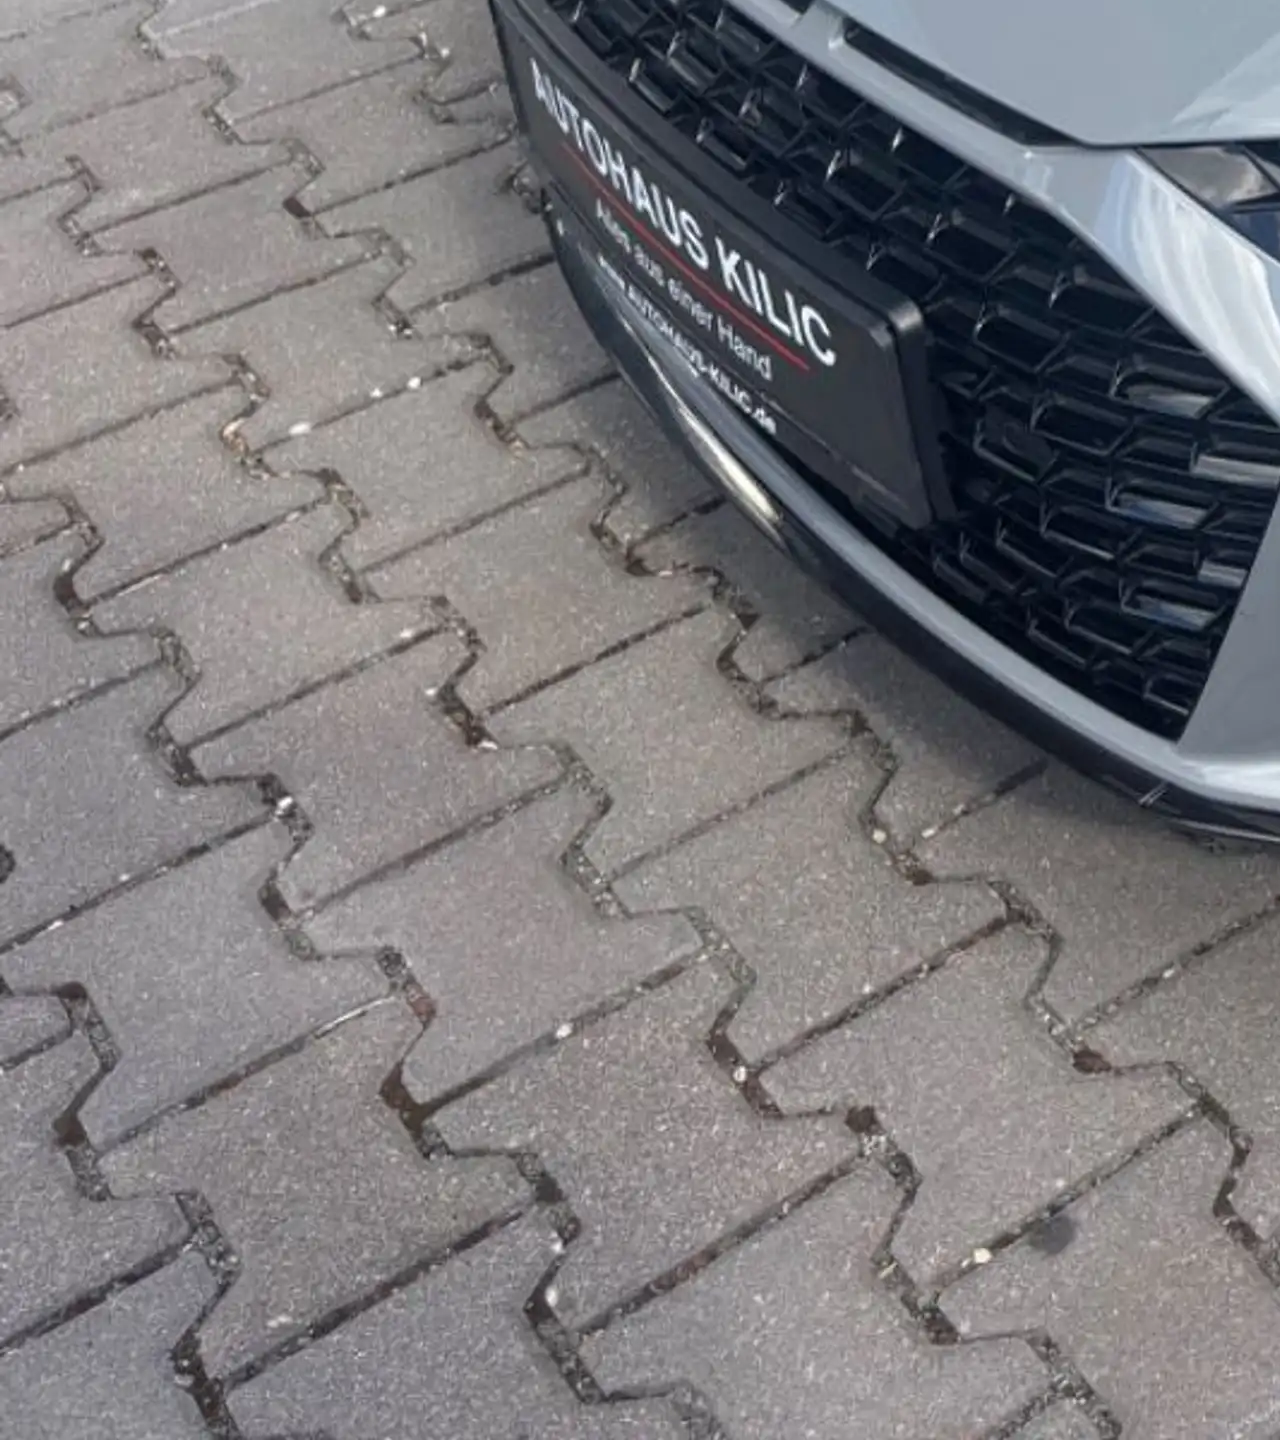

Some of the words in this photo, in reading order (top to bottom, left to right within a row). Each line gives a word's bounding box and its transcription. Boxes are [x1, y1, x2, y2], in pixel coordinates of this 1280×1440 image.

[528, 56, 709, 273] AUTOHAUS
[716, 231, 837, 368] KILIC
[667, 277, 714, 332] einer
[717, 315, 773, 382] Hand
